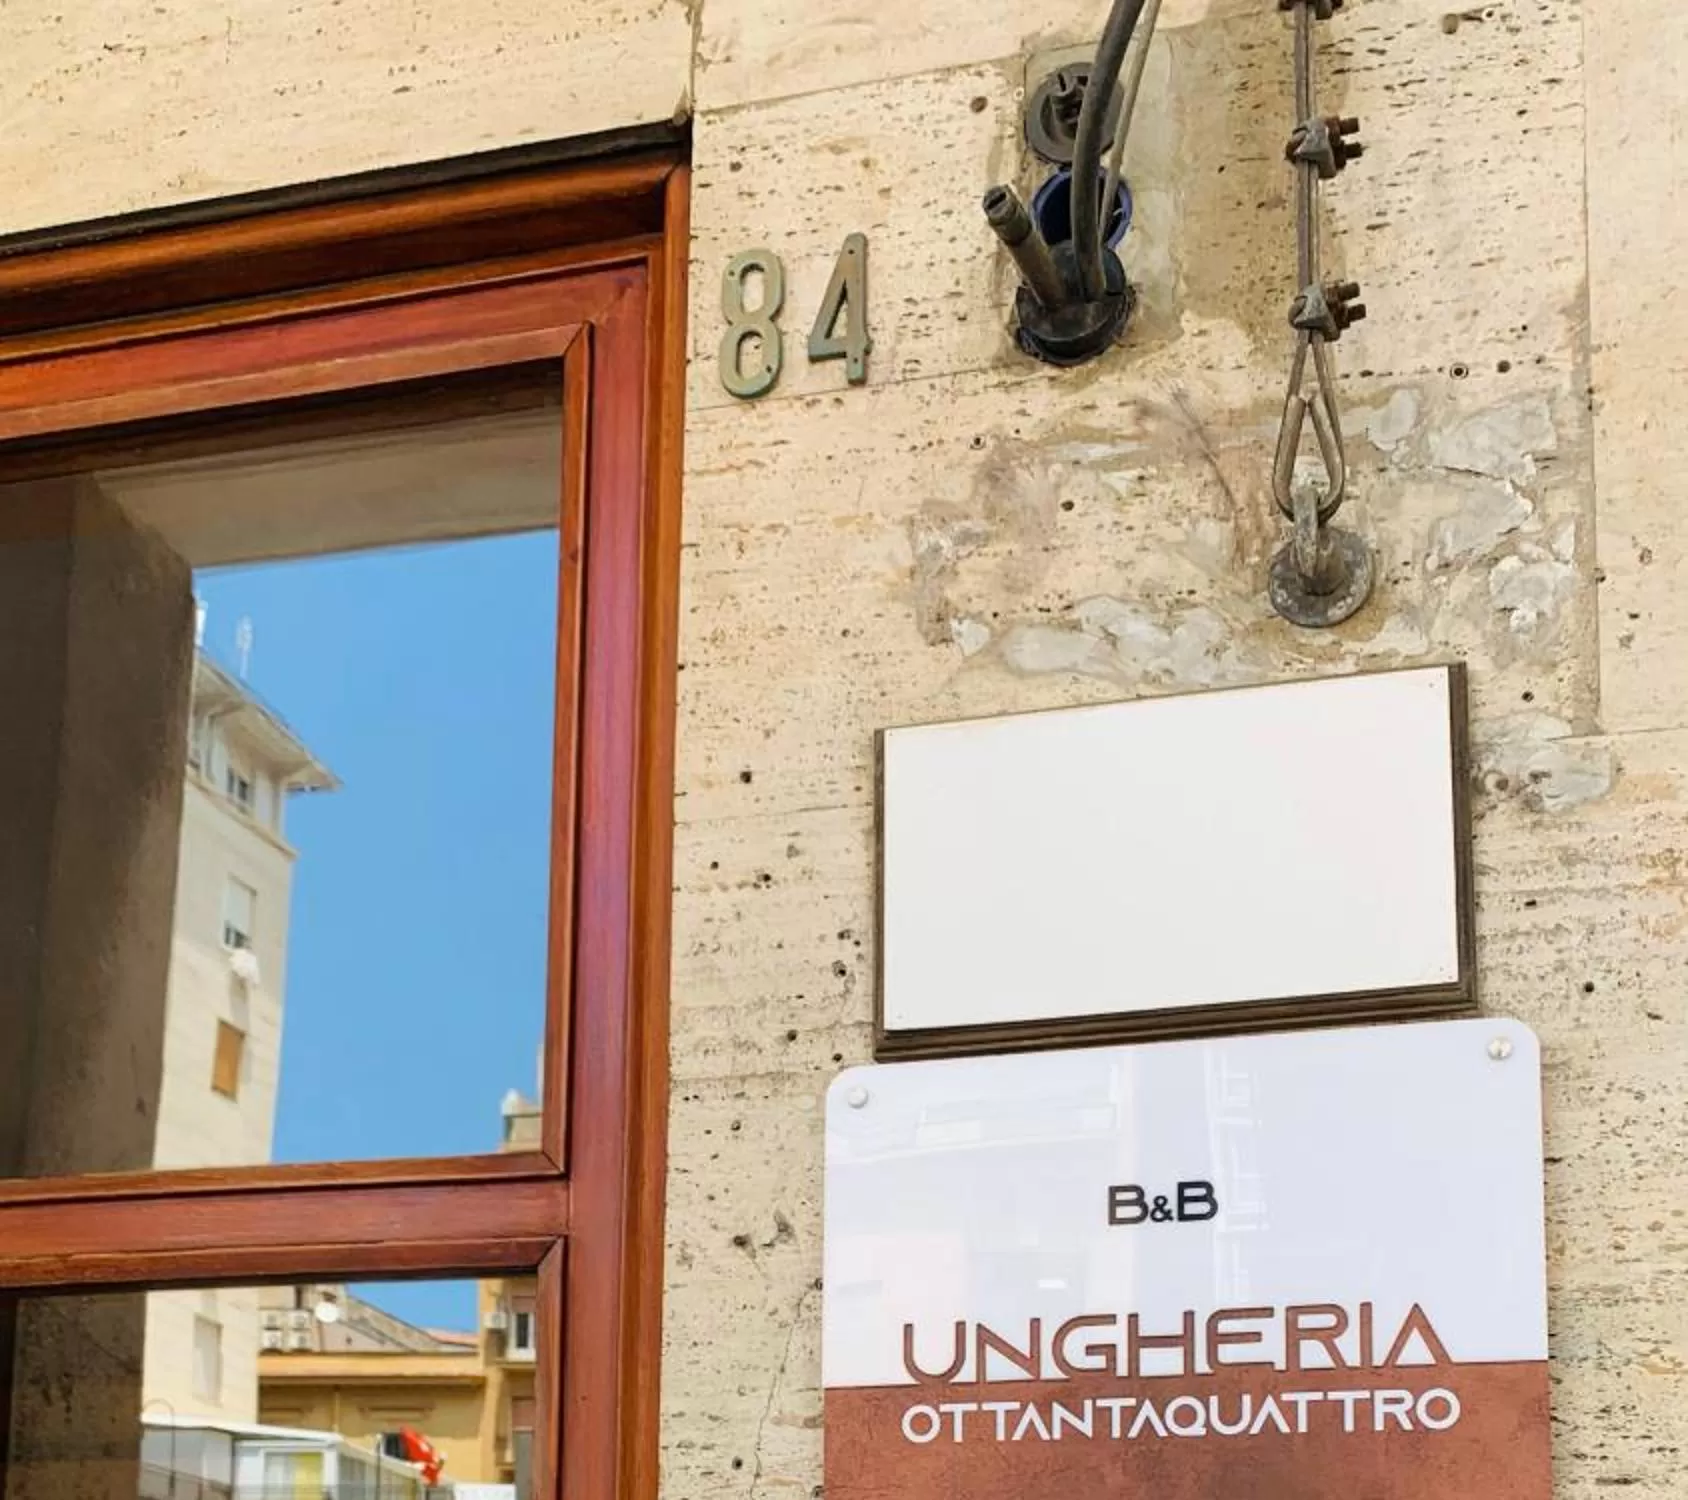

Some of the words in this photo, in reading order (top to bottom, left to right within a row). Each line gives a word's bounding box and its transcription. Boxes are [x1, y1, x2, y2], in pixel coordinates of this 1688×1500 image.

[719, 232, 872, 400] 84
[1107, 1180, 1219, 1226] B&B
[902, 1301, 1455, 1385] UNGHERIA
[901, 1387, 1461, 1444] OTTANTAQUATTRO
